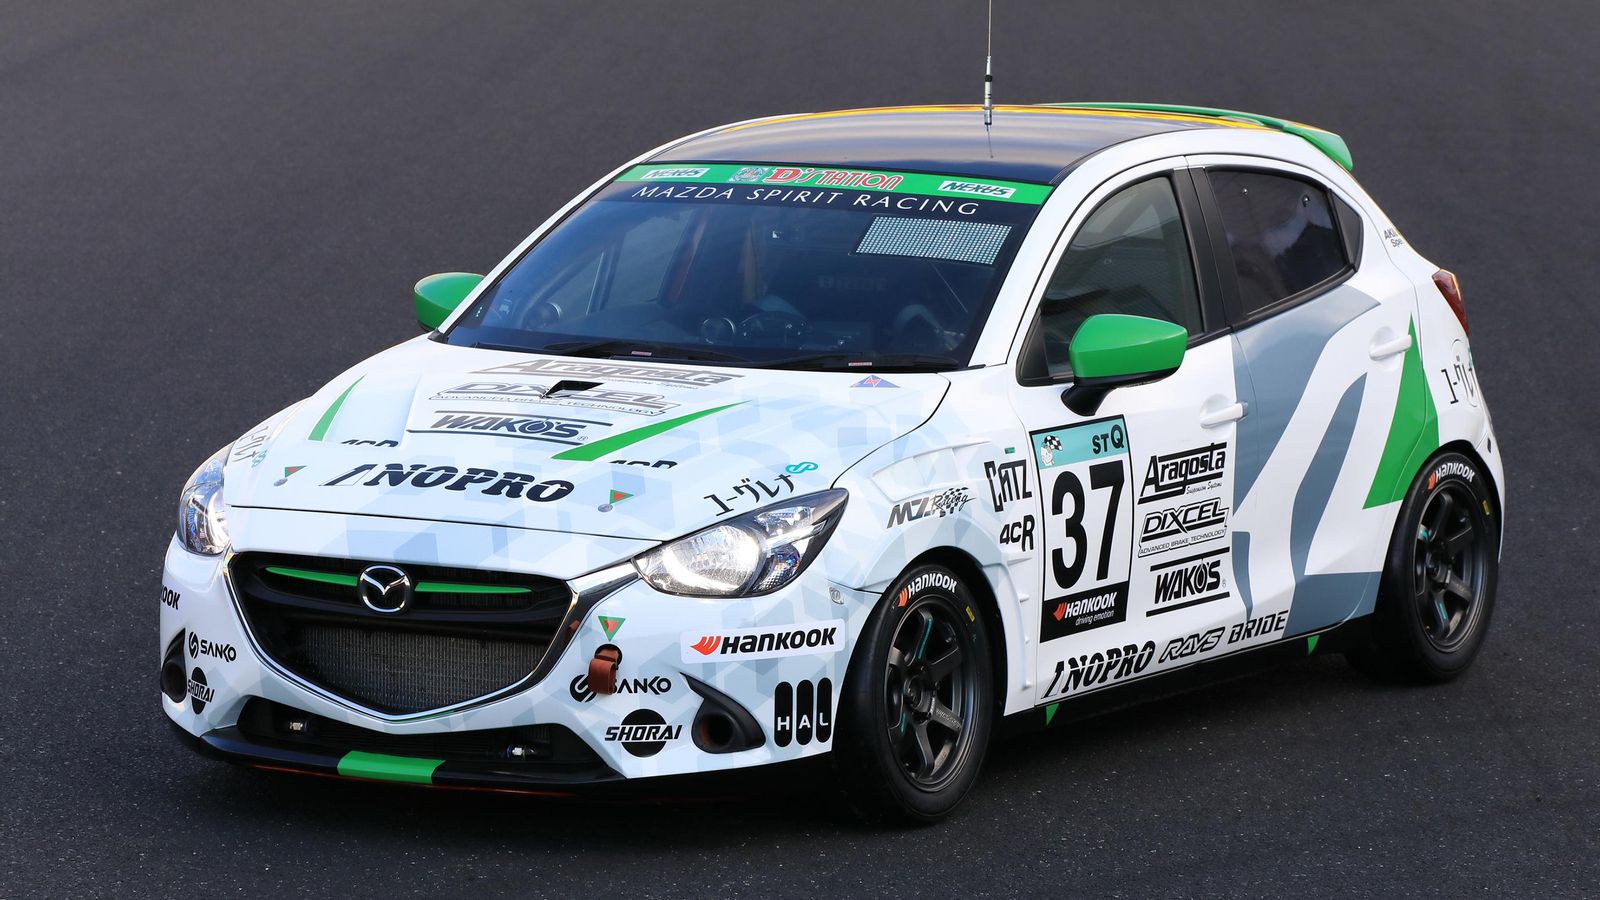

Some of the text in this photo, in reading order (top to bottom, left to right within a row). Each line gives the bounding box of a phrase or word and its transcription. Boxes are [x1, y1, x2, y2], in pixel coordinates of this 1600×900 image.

[632, 186, 979, 215] MAZDA SPIRIT RACING
[943, 182, 1010, 196] NEXUS
[478, 359, 734, 385] Aragosta
[430, 415, 587, 439] WAKO'S
[1140, 443, 1226, 497] Aragosta
[703, 473, 795, 516] ユーグレナ
[1052, 460, 1125, 589] 37
[1143, 501, 1225, 534] DIXCEL
[1000, 514, 1035, 552] 4CR
[1140, 529, 1225, 554] ADVANCED BRAKE TECHNOLOGY
[1154, 559, 1221, 604] WAKO'S
[1075, 609, 1114, 626] driving emotion
[200, 639, 237, 662] SANKO
[1158, 626, 1226, 664] RAYS
[1228, 610, 1289, 645] BRIDE
[188, 679, 215, 703] SHORAI
[604, 725, 683, 741] SHORAI
